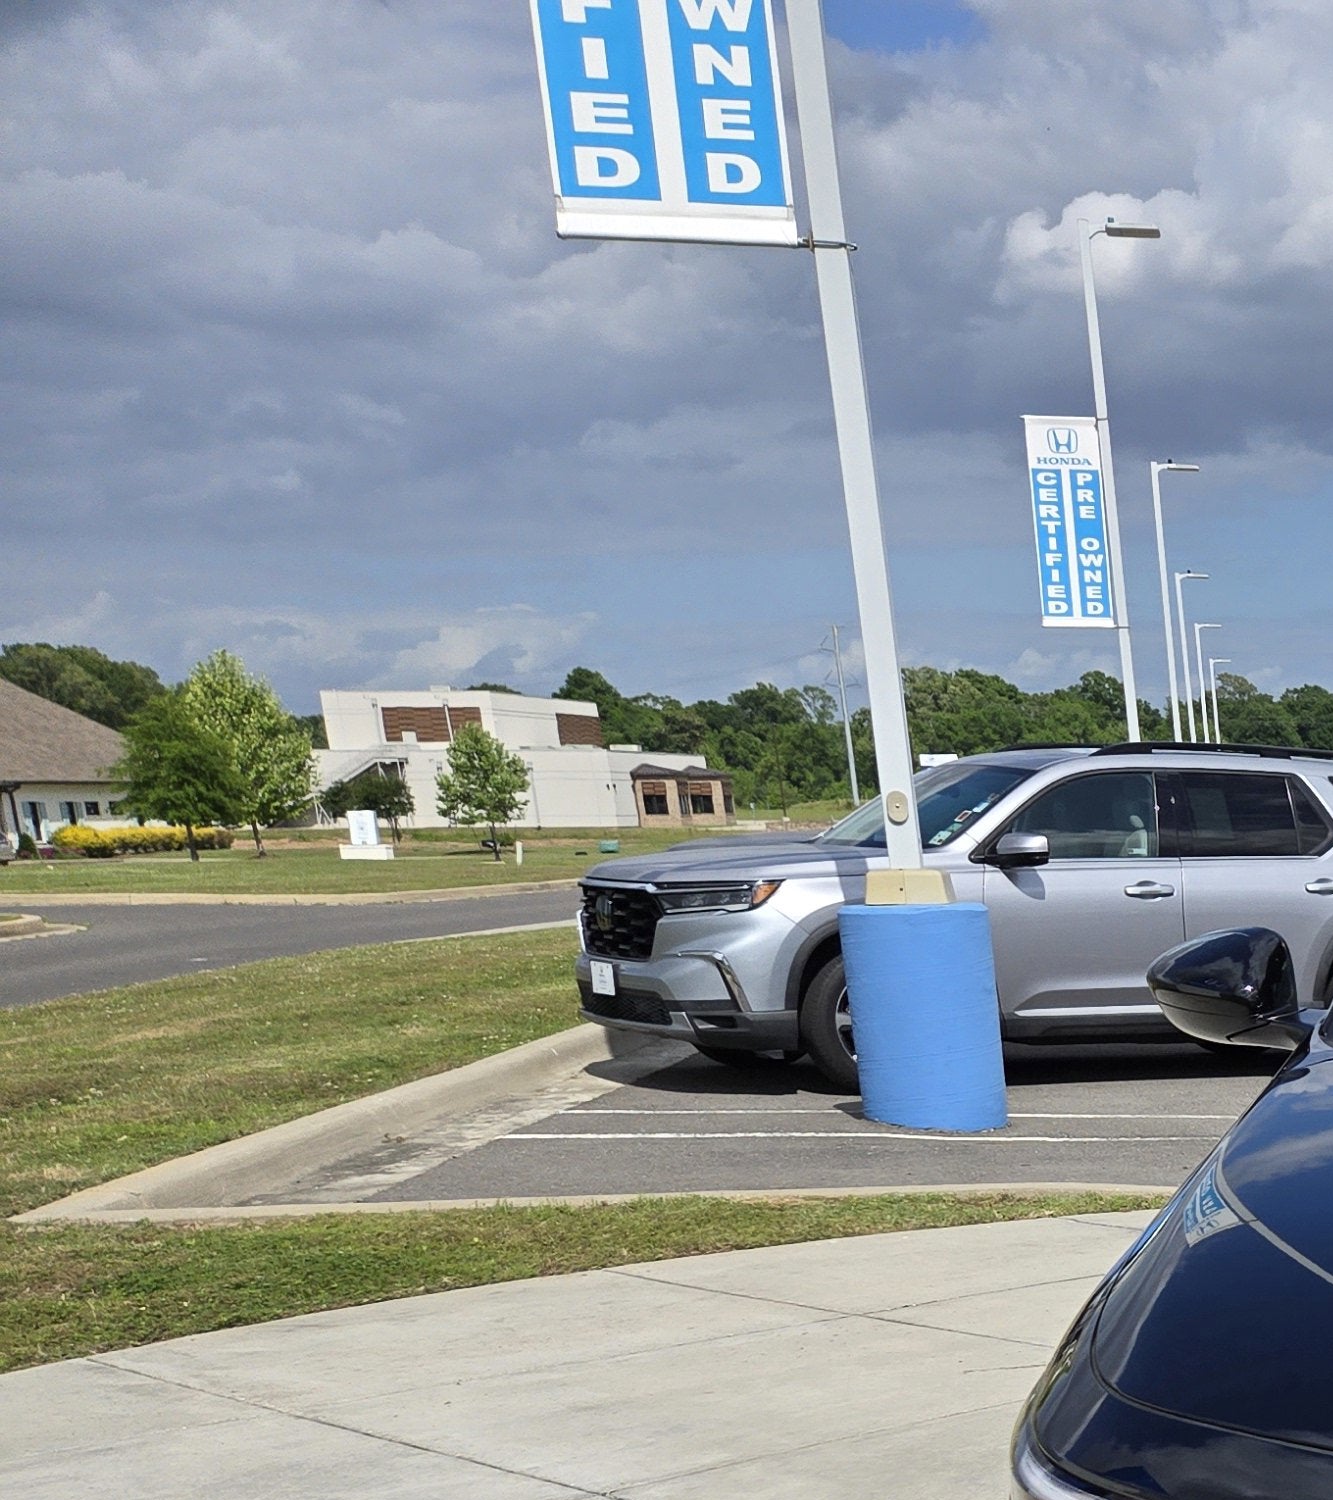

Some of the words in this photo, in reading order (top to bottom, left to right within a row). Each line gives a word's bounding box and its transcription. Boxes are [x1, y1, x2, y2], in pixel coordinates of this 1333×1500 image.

[1036, 456, 1092, 466] HONDA
[1076, 472, 1096, 519] PRE
[1036, 472, 1069, 614] CERTIFIED
[1078, 537, 1104, 615] OWNED
